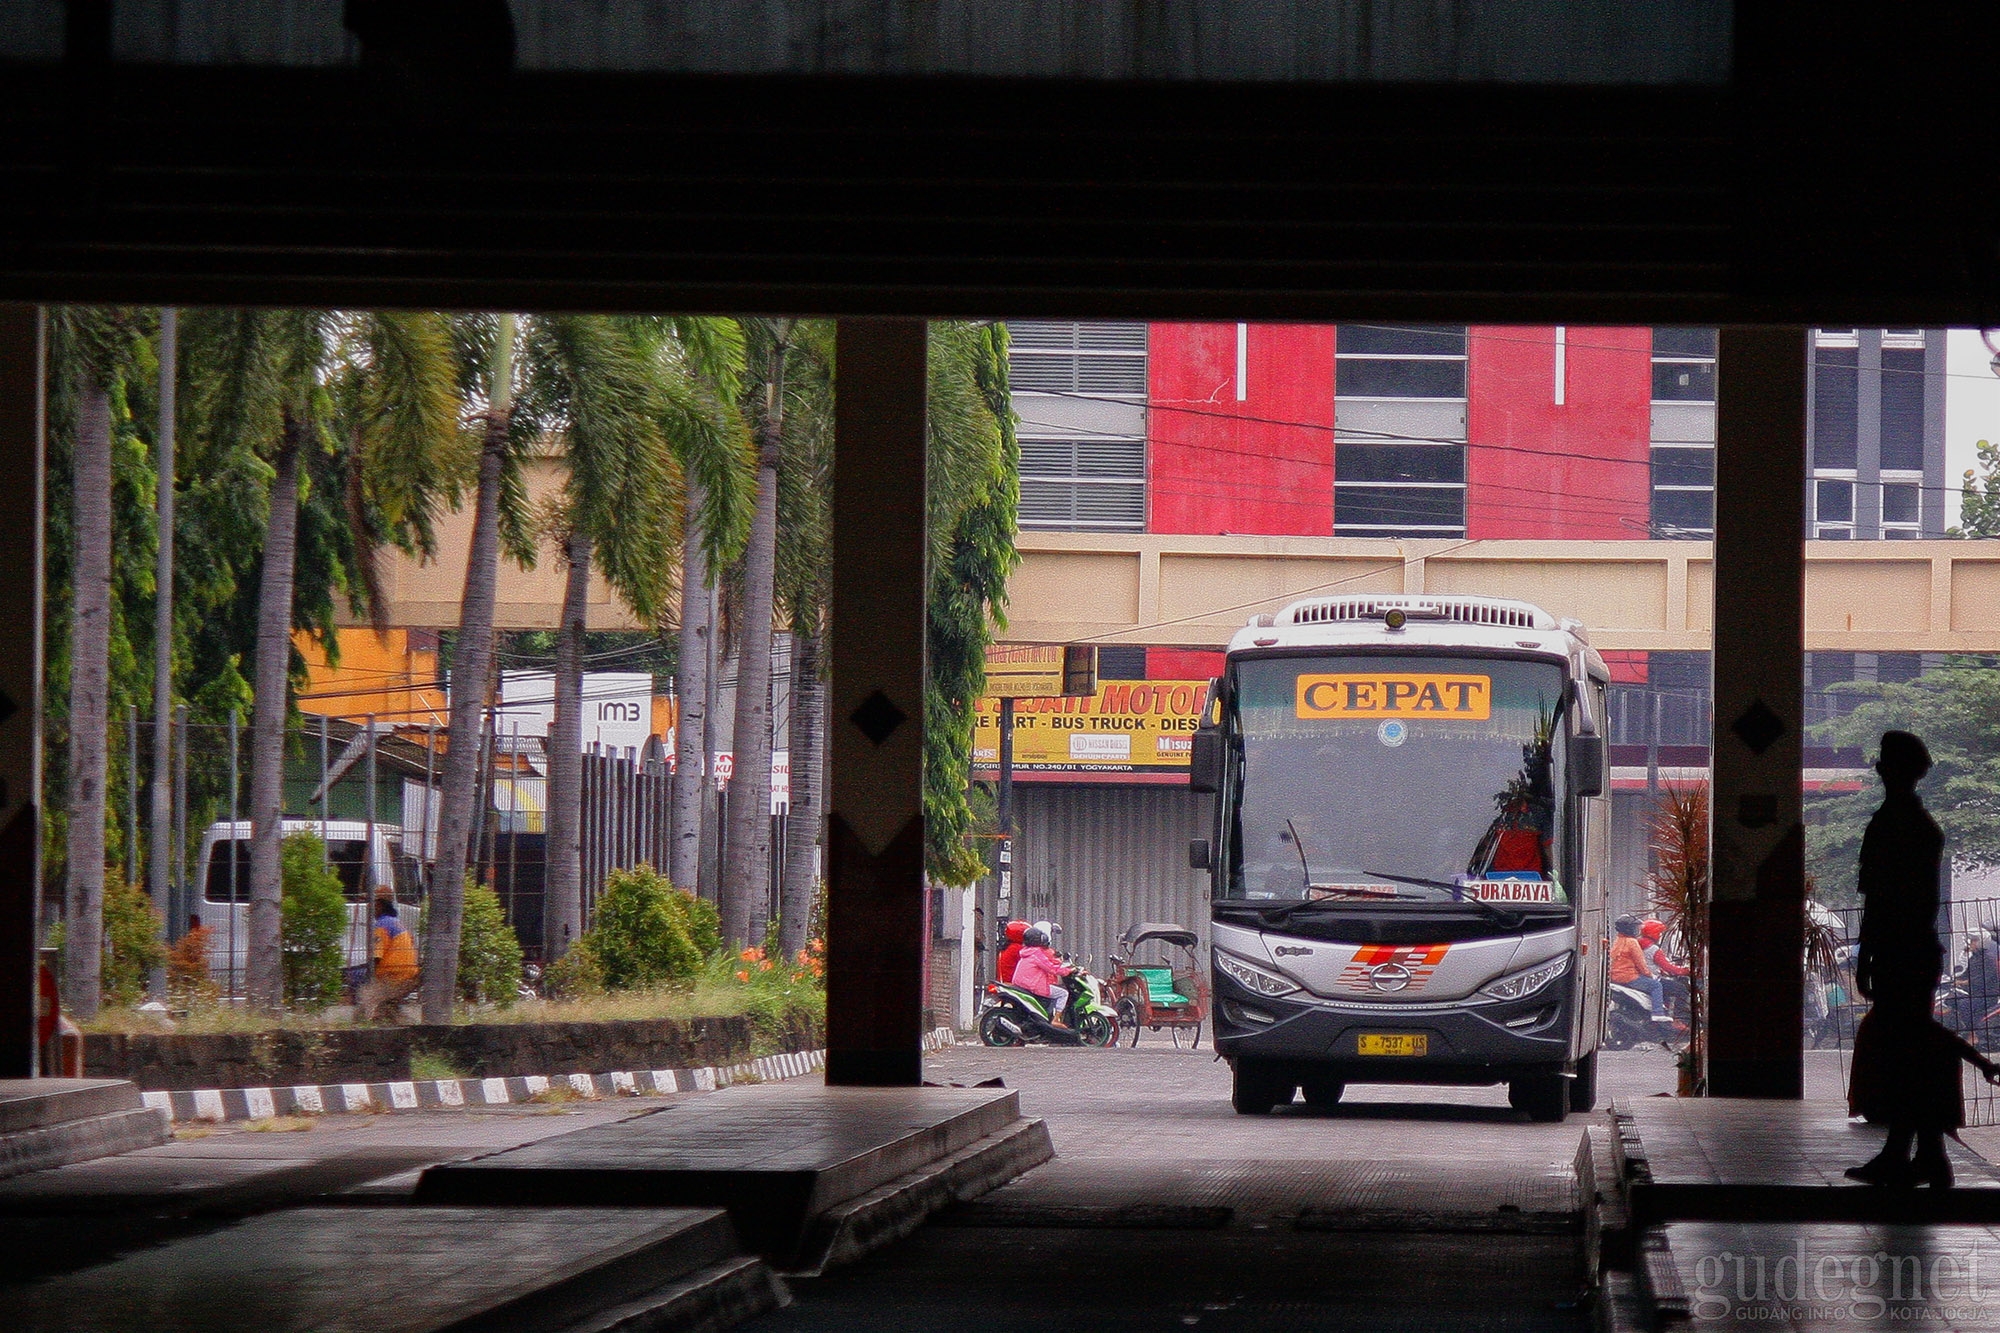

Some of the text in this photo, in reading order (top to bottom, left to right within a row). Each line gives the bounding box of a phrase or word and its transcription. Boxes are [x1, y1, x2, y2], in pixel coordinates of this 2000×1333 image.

[1304, 681, 1483, 712] CEPAT
[598, 702, 641, 721] IM3
[1051, 717, 1085, 729] BUS
[1091, 717, 1146, 730] TRUCK
[1080, 764, 1133, 772] YOGYAKARTA
[1470, 883, 1550, 902] SURABAYA
[1380, 1036, 1403, 1049] 7537
